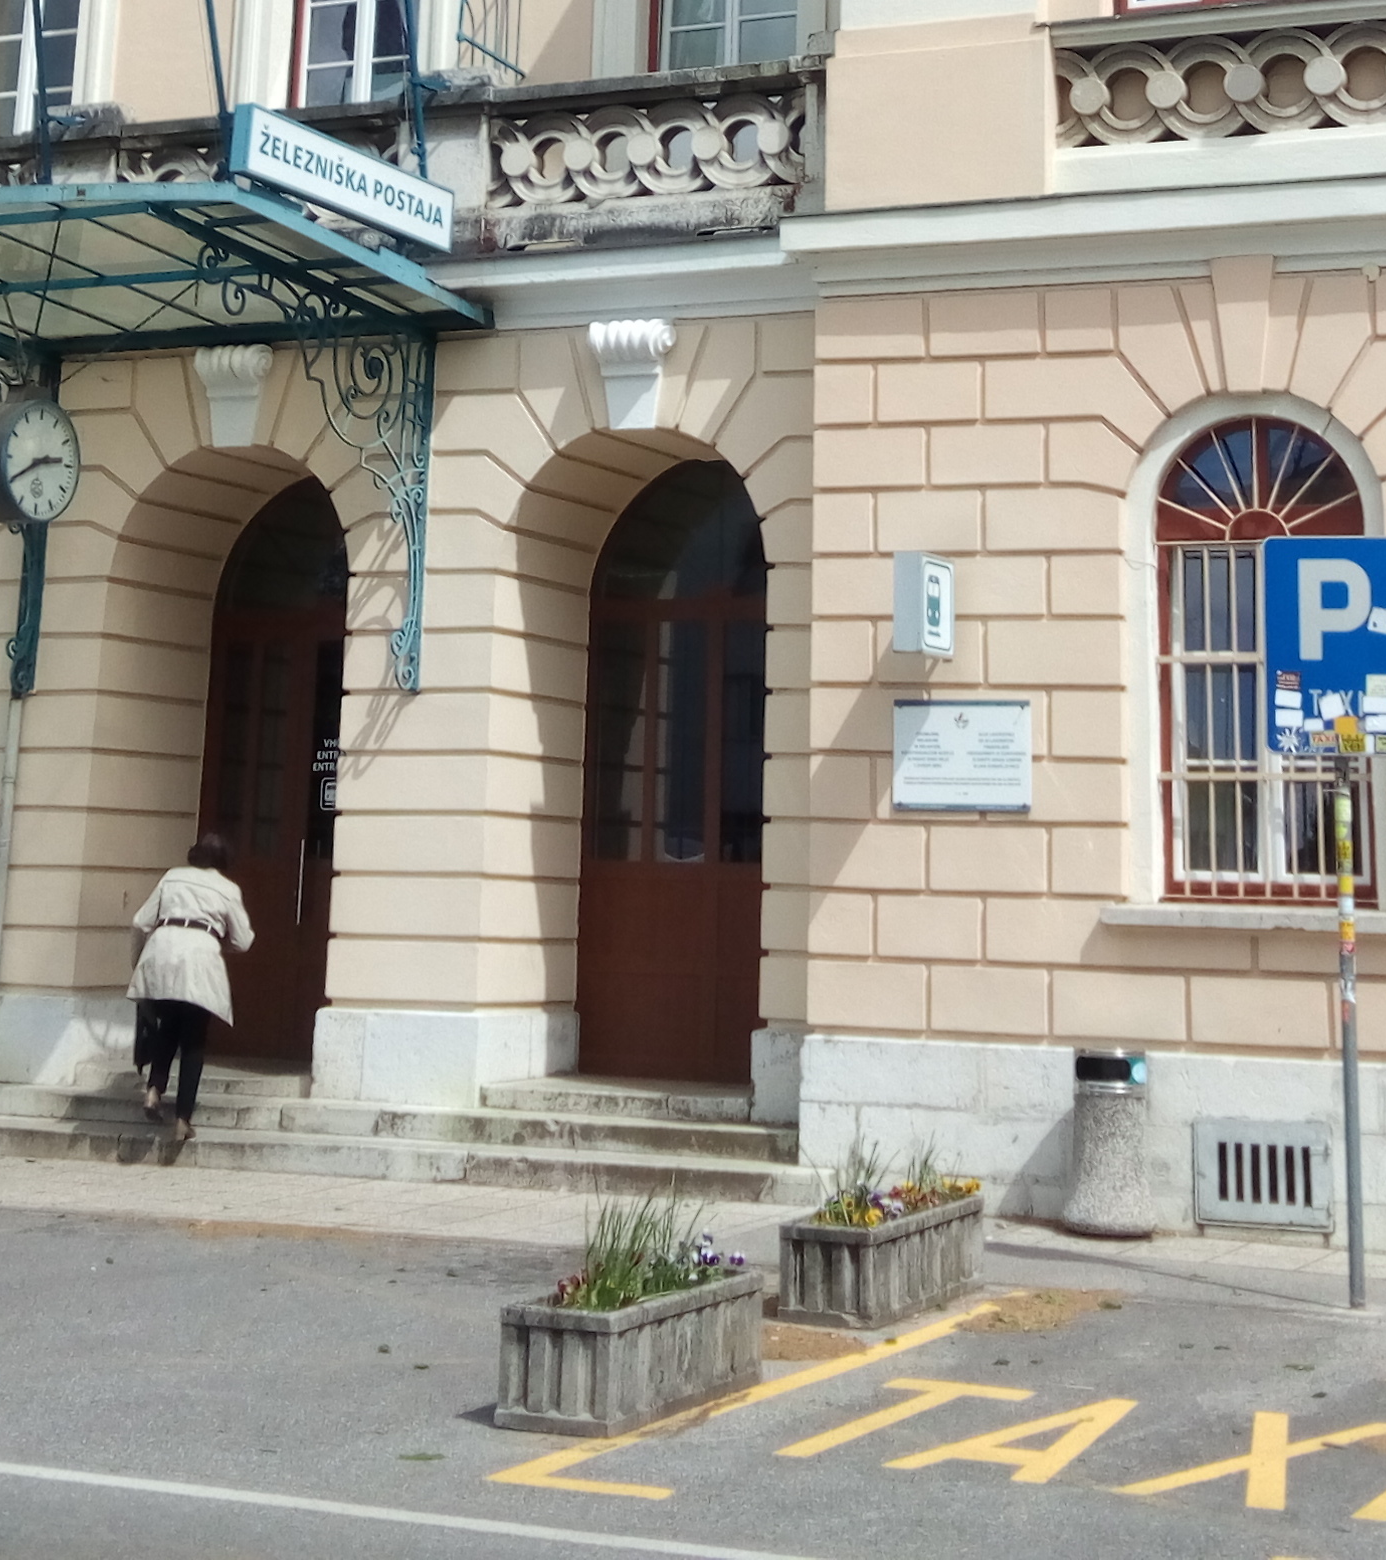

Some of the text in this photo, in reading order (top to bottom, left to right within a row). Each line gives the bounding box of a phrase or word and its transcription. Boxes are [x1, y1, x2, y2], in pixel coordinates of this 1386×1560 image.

[260, 124, 444, 229] ŽELEZNIŠKA POSTAJA
[1297, 557, 1372, 661] P
[1308, 688, 1364, 717] TXI
